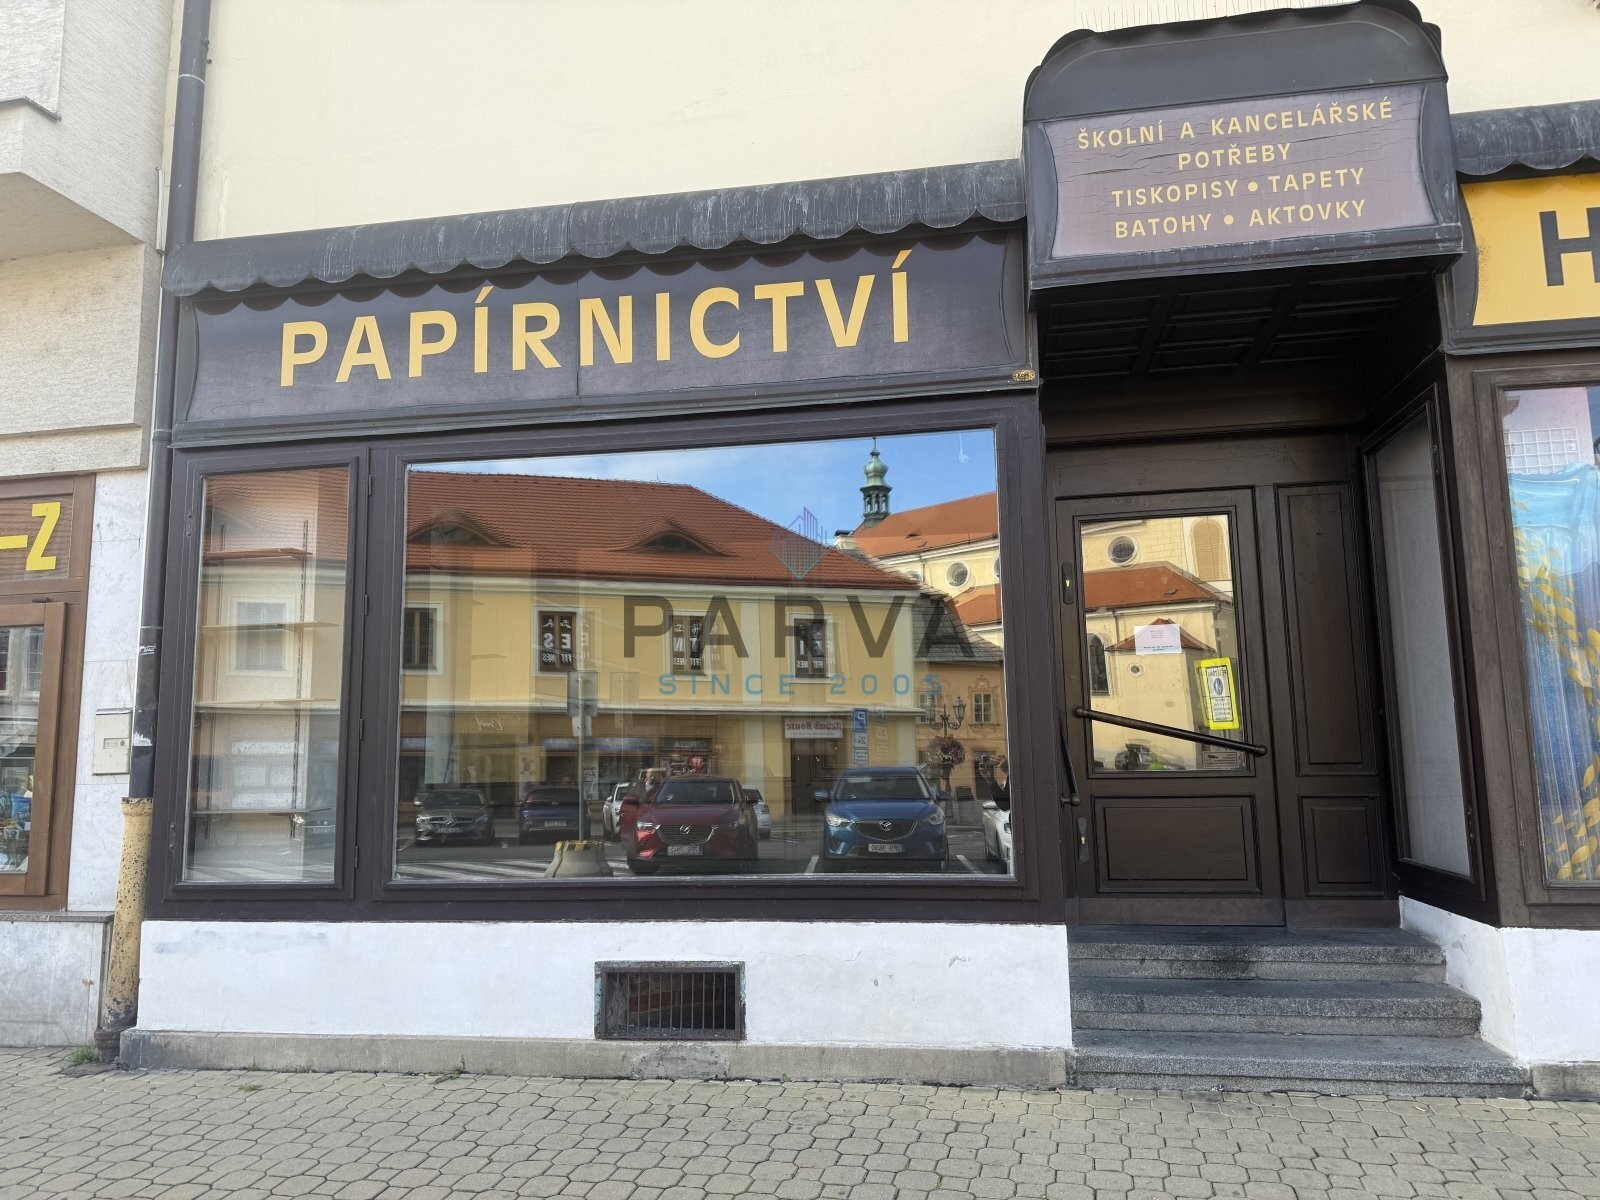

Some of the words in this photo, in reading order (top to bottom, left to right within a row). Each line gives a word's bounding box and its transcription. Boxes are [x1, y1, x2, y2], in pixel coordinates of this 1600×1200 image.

[1078, 120, 1163, 149] ŠKOLNÍ
[1180, 122, 1195, 139] A
[1211, 96, 1393, 136] KANCELÁŘSKÉ
[1178, 143, 1291, 170] POTŘEBY
[1112, 179, 1238, 207] TISKOPISY
[1268, 167, 1364, 193] TAPETY
[1115, 213, 1212, 238] BATOHY
[1249, 199, 1366, 227] AKTOVKY
[1539, 206, 1600, 286] H
[281, 249, 912, 386] PAPÍRNICTVÍ
